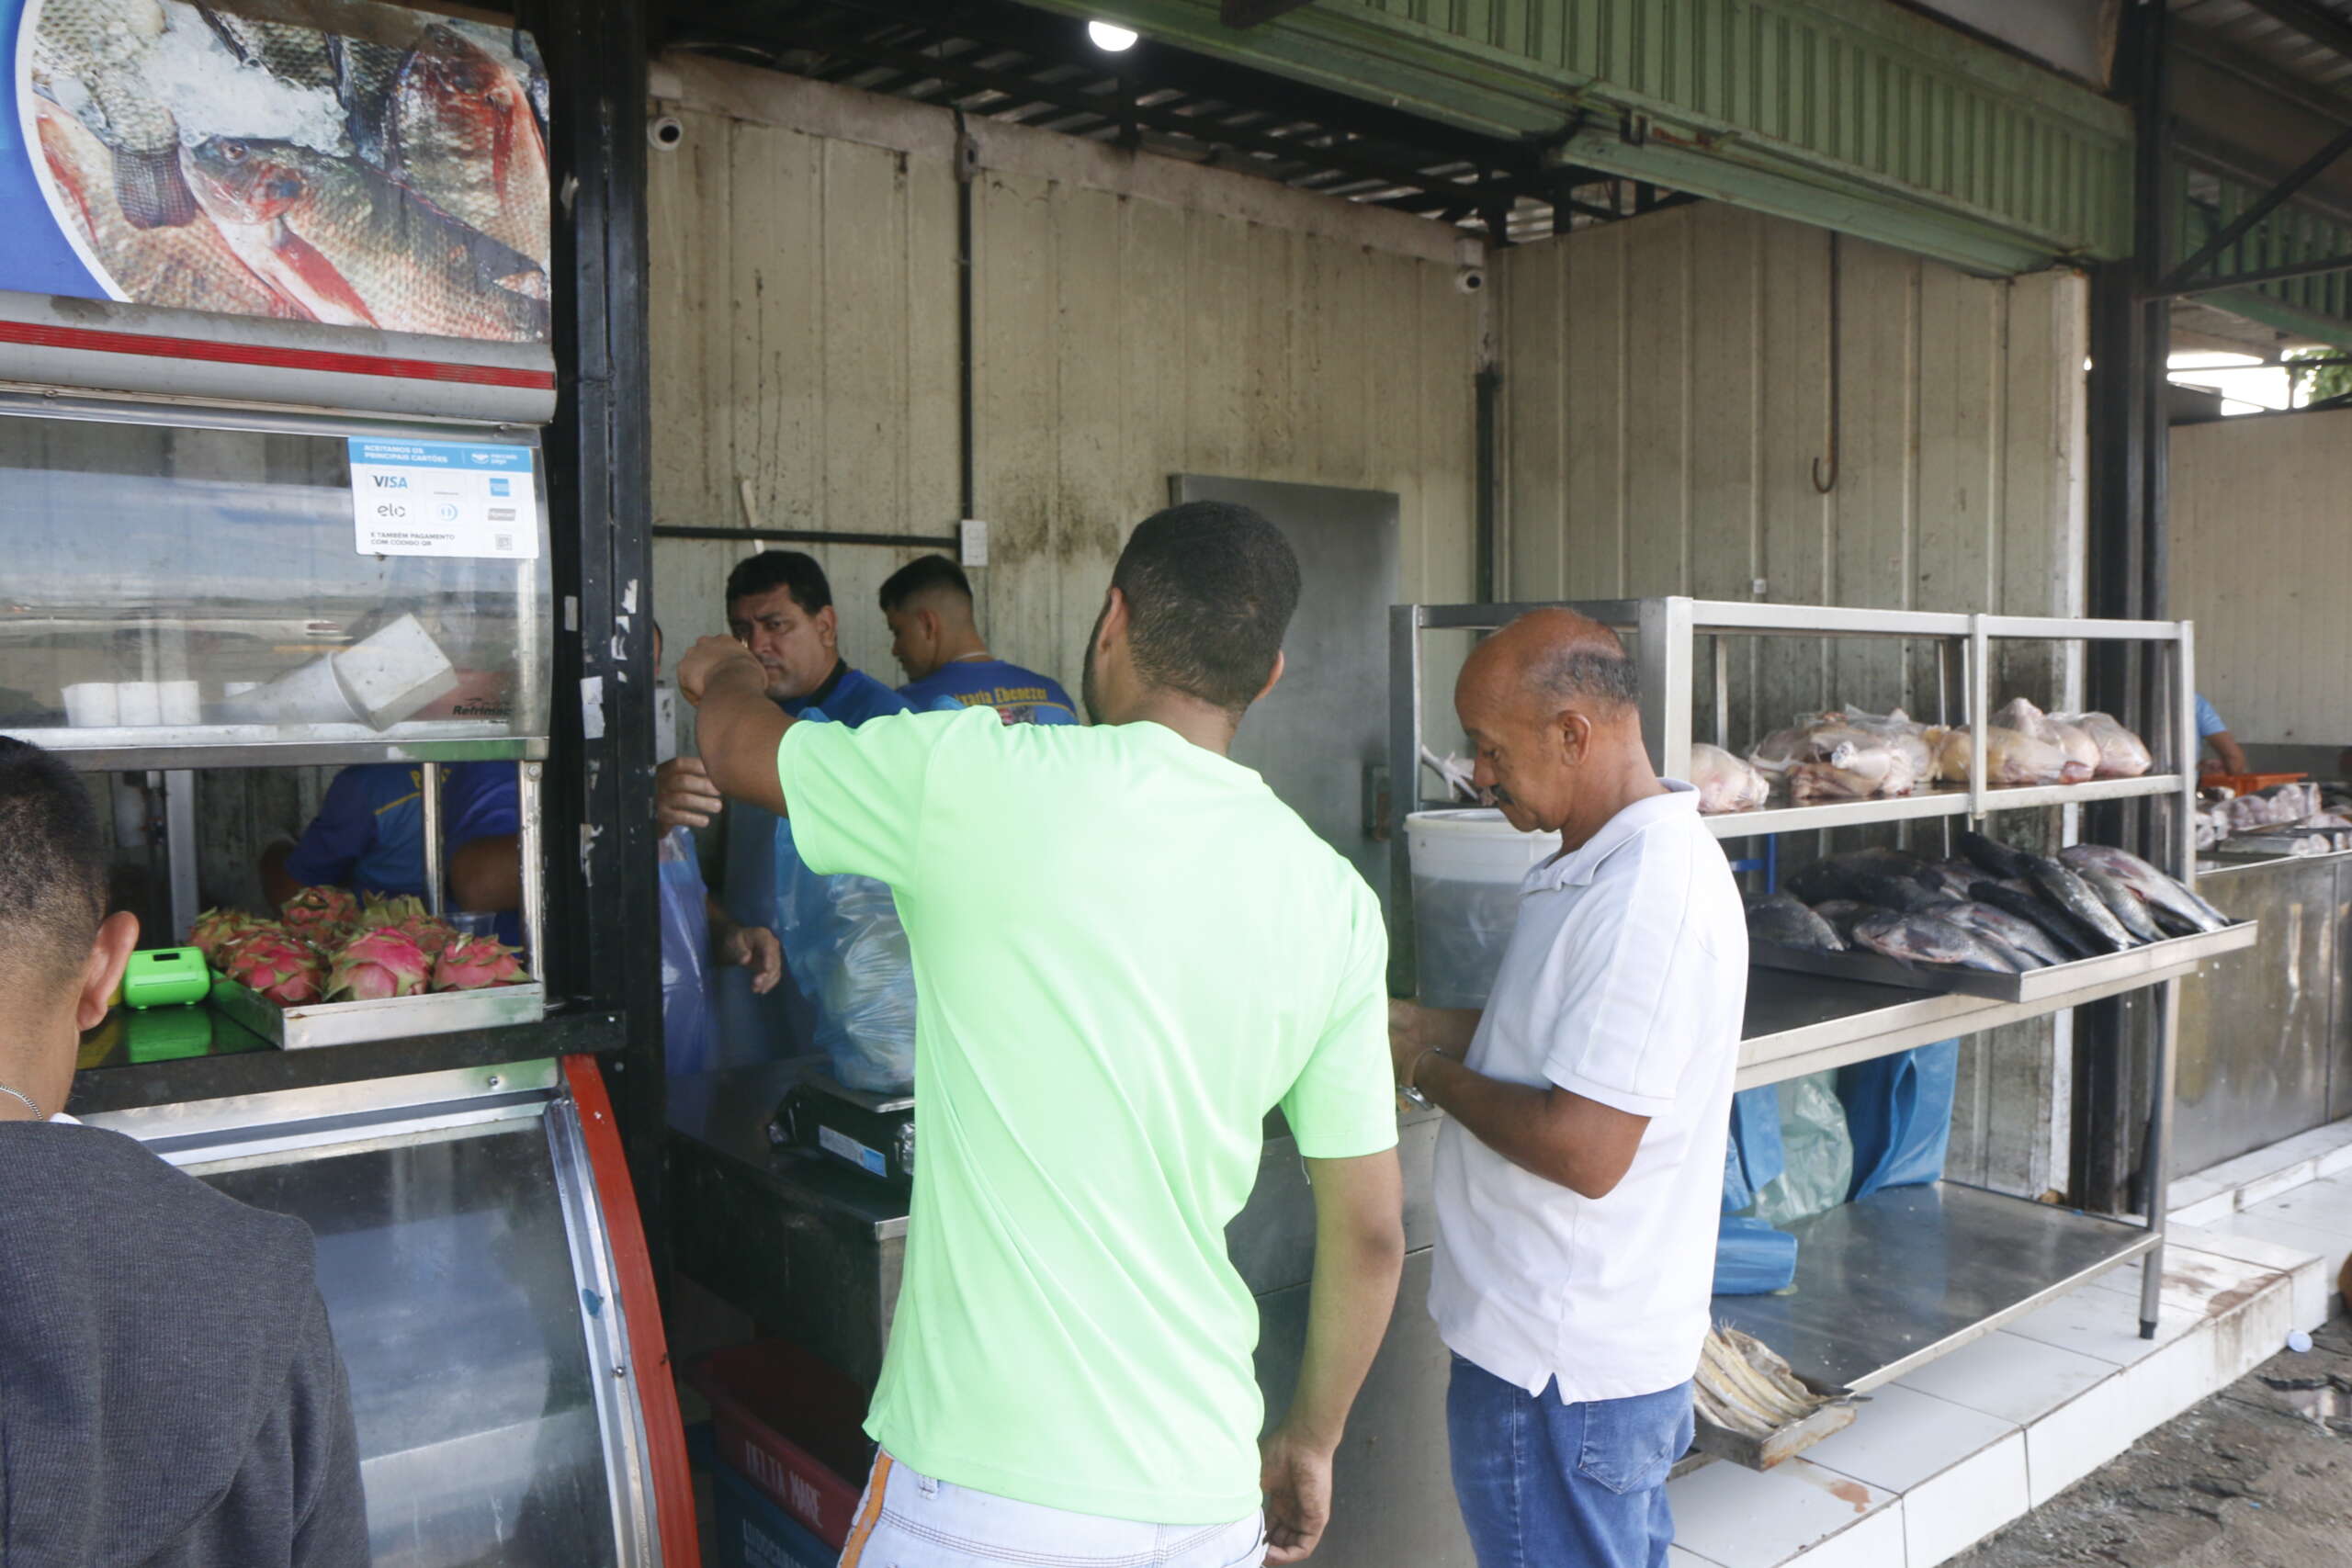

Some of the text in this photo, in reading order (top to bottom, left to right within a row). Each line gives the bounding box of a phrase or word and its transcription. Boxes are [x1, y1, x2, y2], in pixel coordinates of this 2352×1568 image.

[364, 445, 411, 454] ACEITAMOS
[365, 452, 410, 461] PRINCIPAIS
[373, 475, 408, 489] VISA
[377, 503, 406, 517] elo
